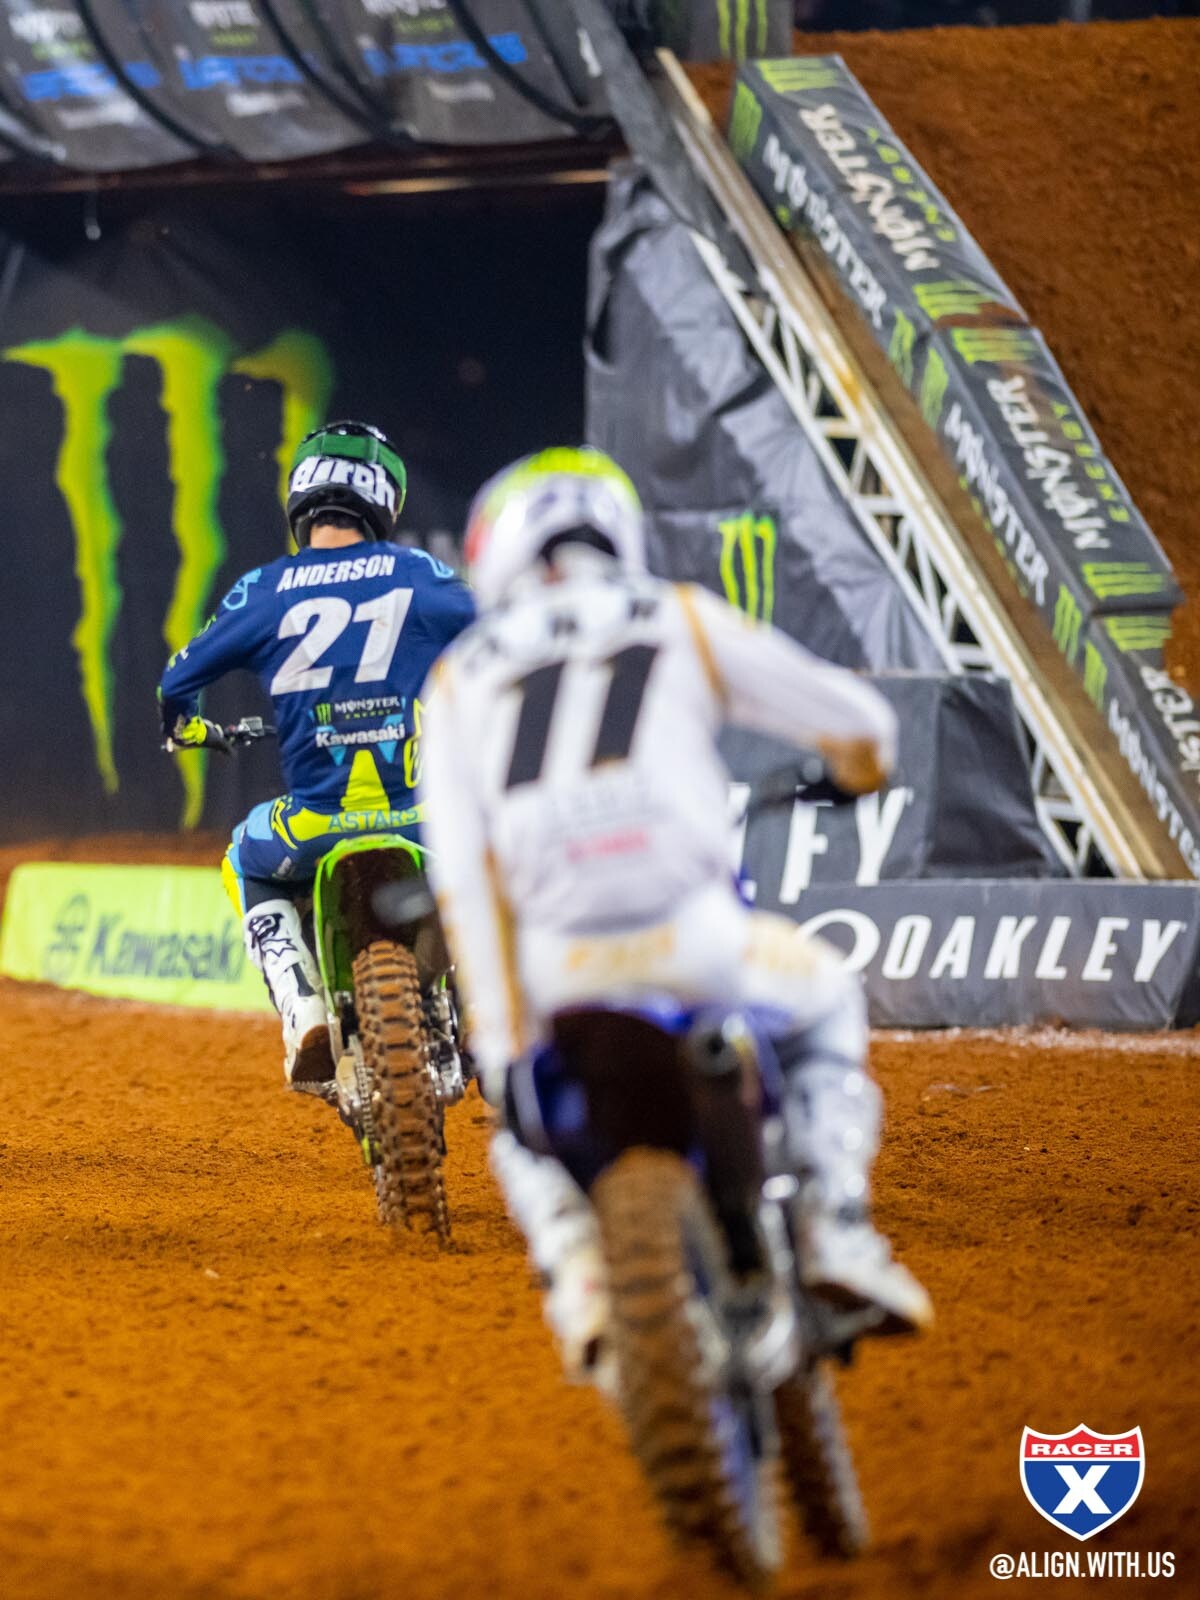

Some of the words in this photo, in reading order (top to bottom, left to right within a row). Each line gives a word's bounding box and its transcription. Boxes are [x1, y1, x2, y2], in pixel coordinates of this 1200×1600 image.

[276, 554, 396, 593] ANDERSON
[270, 587, 413, 697] 21
[334, 696, 400, 713] MONSTER
[501, 644, 659, 794] 11
[315, 723, 405, 748] Kawasaki
[881, 914, 1181, 983] OAKLEY
